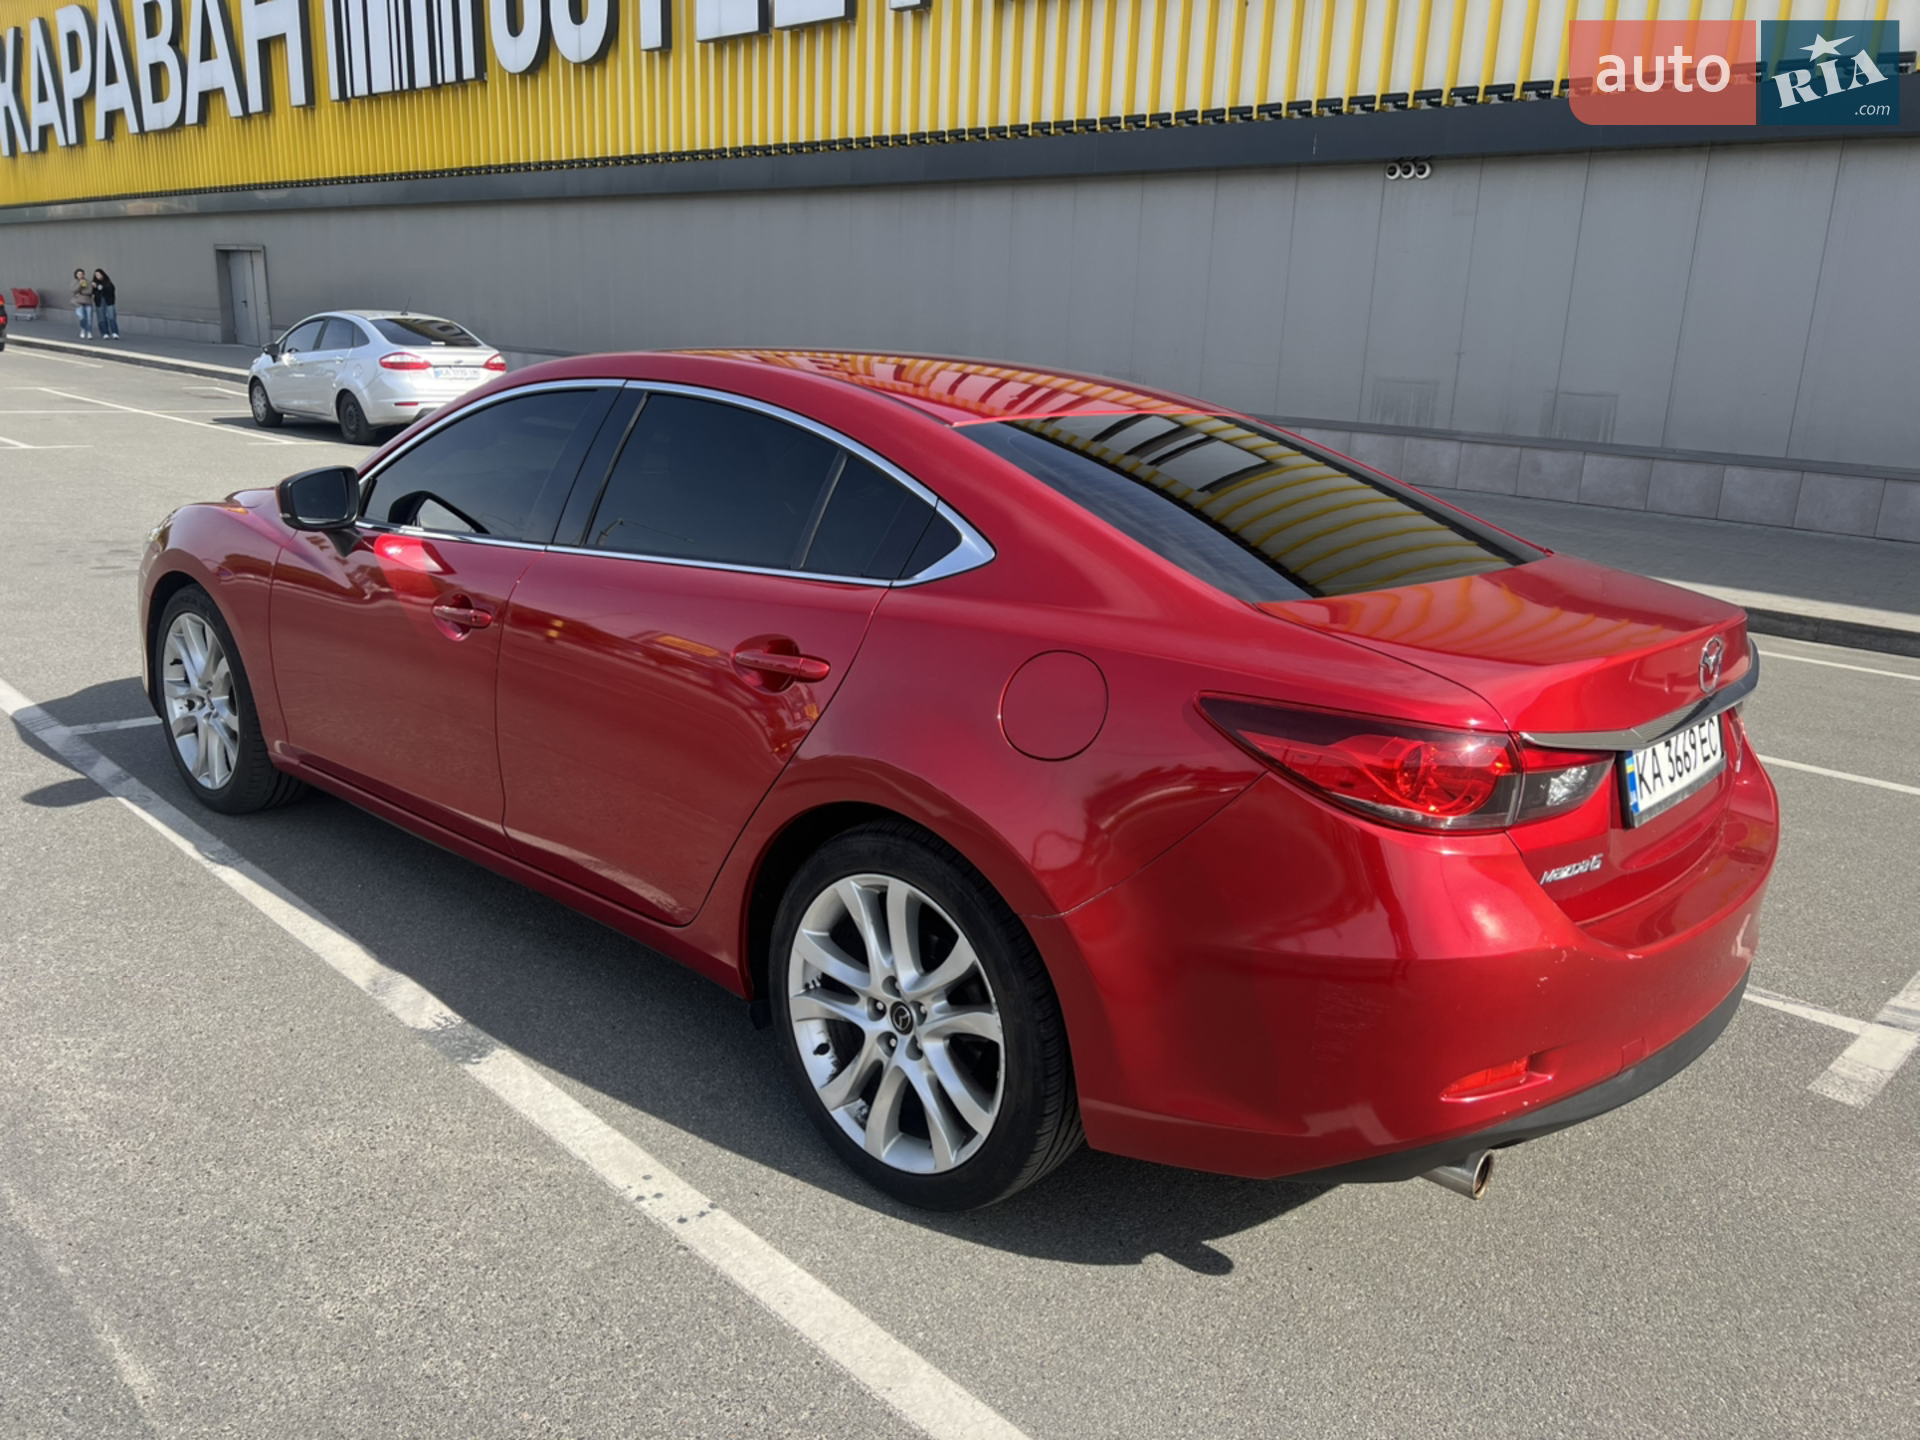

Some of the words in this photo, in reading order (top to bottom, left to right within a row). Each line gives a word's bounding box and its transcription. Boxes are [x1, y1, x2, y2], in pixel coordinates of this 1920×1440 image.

[0, 0, 308, 157] КАРАВАН
[1636, 749, 1664, 798] KA
[1665, 729, 1697, 782] 3669
